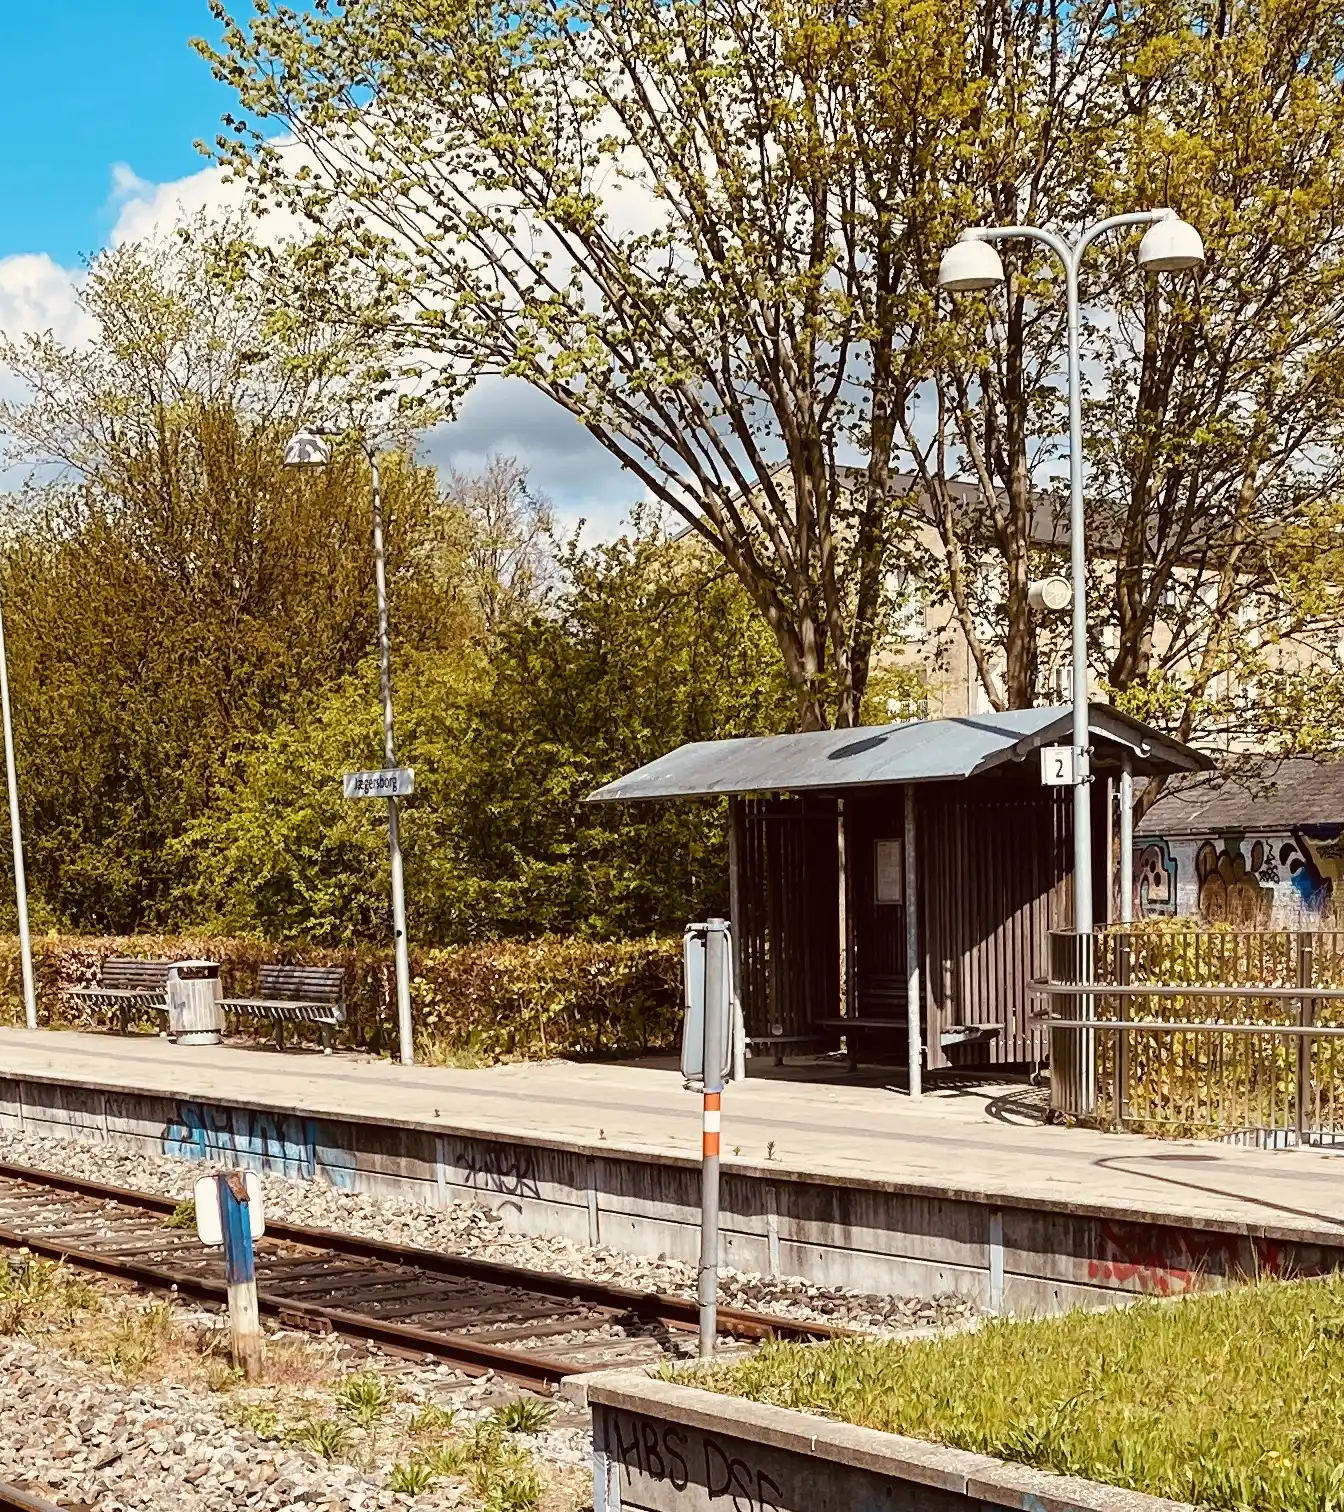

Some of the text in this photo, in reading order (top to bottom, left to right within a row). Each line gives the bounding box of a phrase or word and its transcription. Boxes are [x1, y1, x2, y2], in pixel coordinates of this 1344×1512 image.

[1054, 758, 1064, 778] 2
[354, 774, 398, 794] Jægersborg
[613, 1415, 689, 1493] HBS
